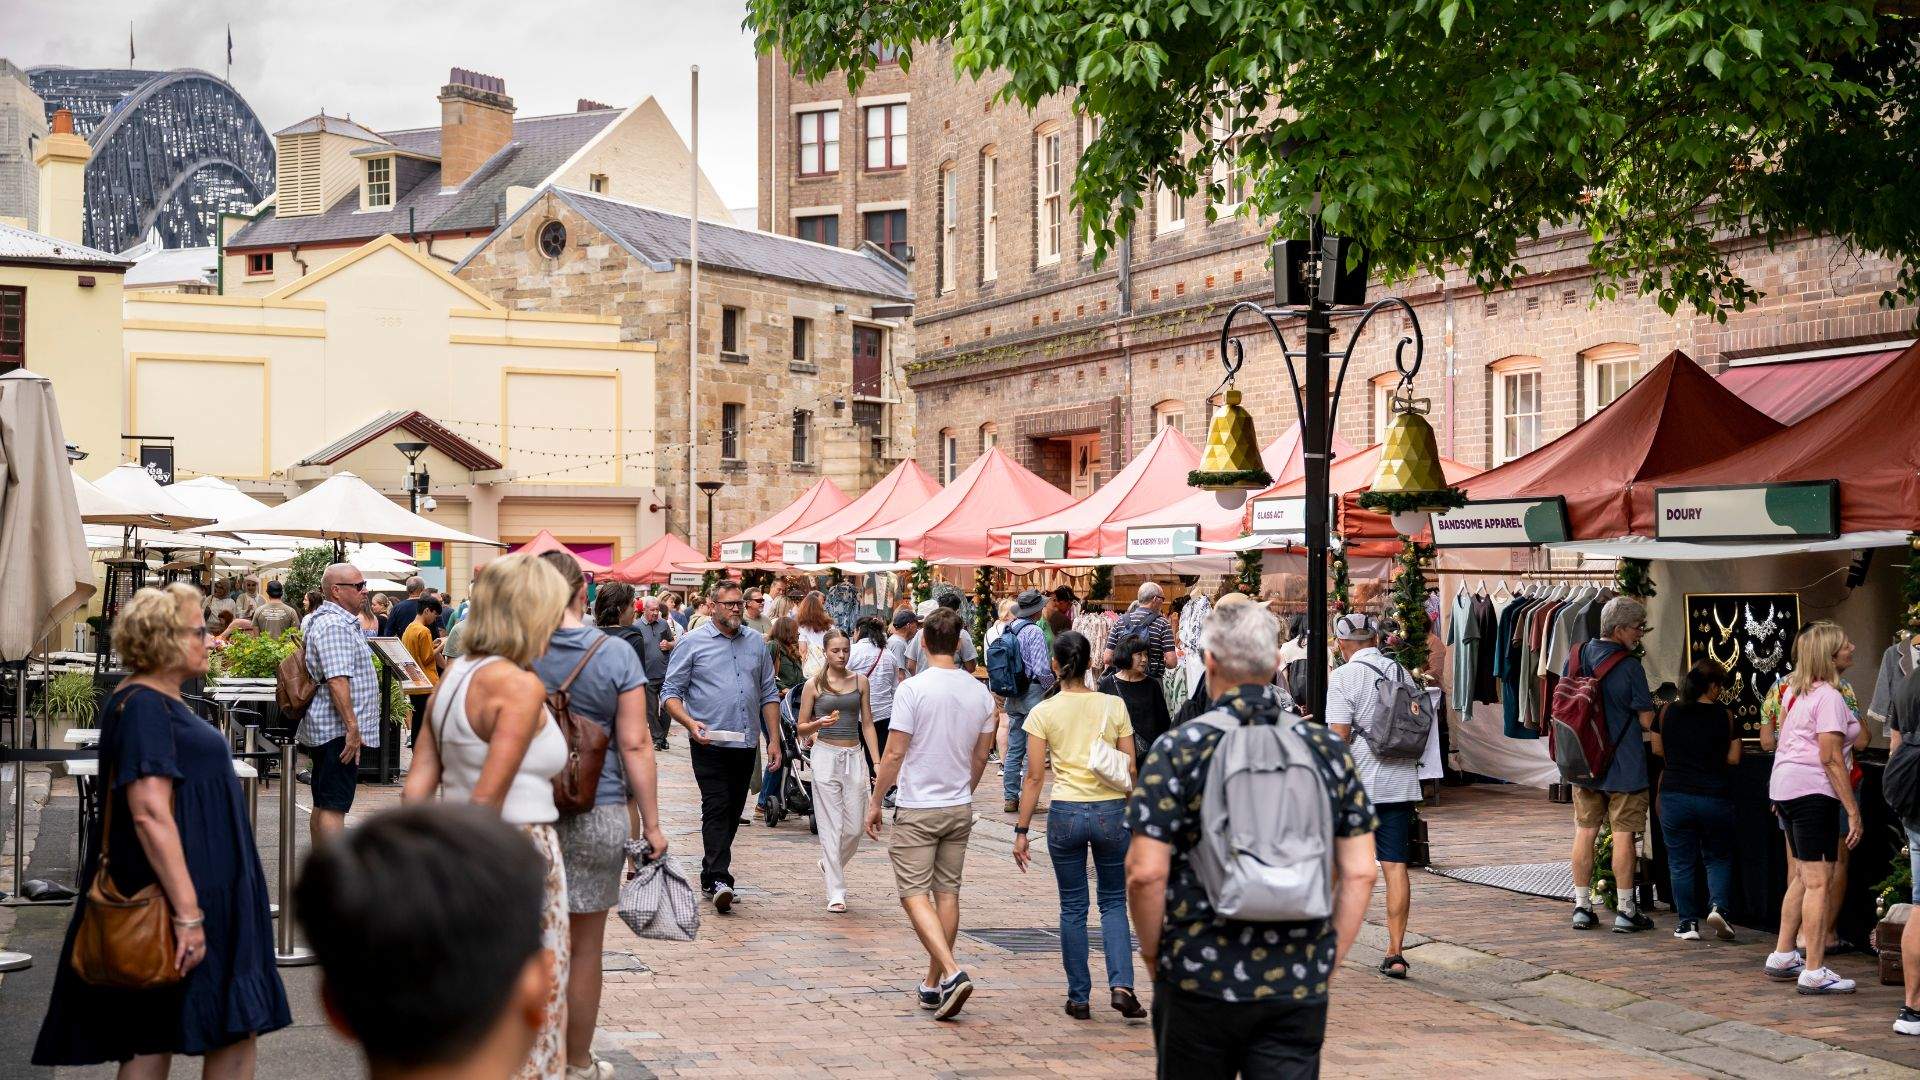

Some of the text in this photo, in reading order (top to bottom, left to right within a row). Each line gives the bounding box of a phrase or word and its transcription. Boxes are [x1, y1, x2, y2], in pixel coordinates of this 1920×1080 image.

[1257, 511, 1284, 519] GLASS ACT
[1666, 508, 1702, 520] DOURY
[1438, 518, 1522, 530] BANDSOME APPAREL
